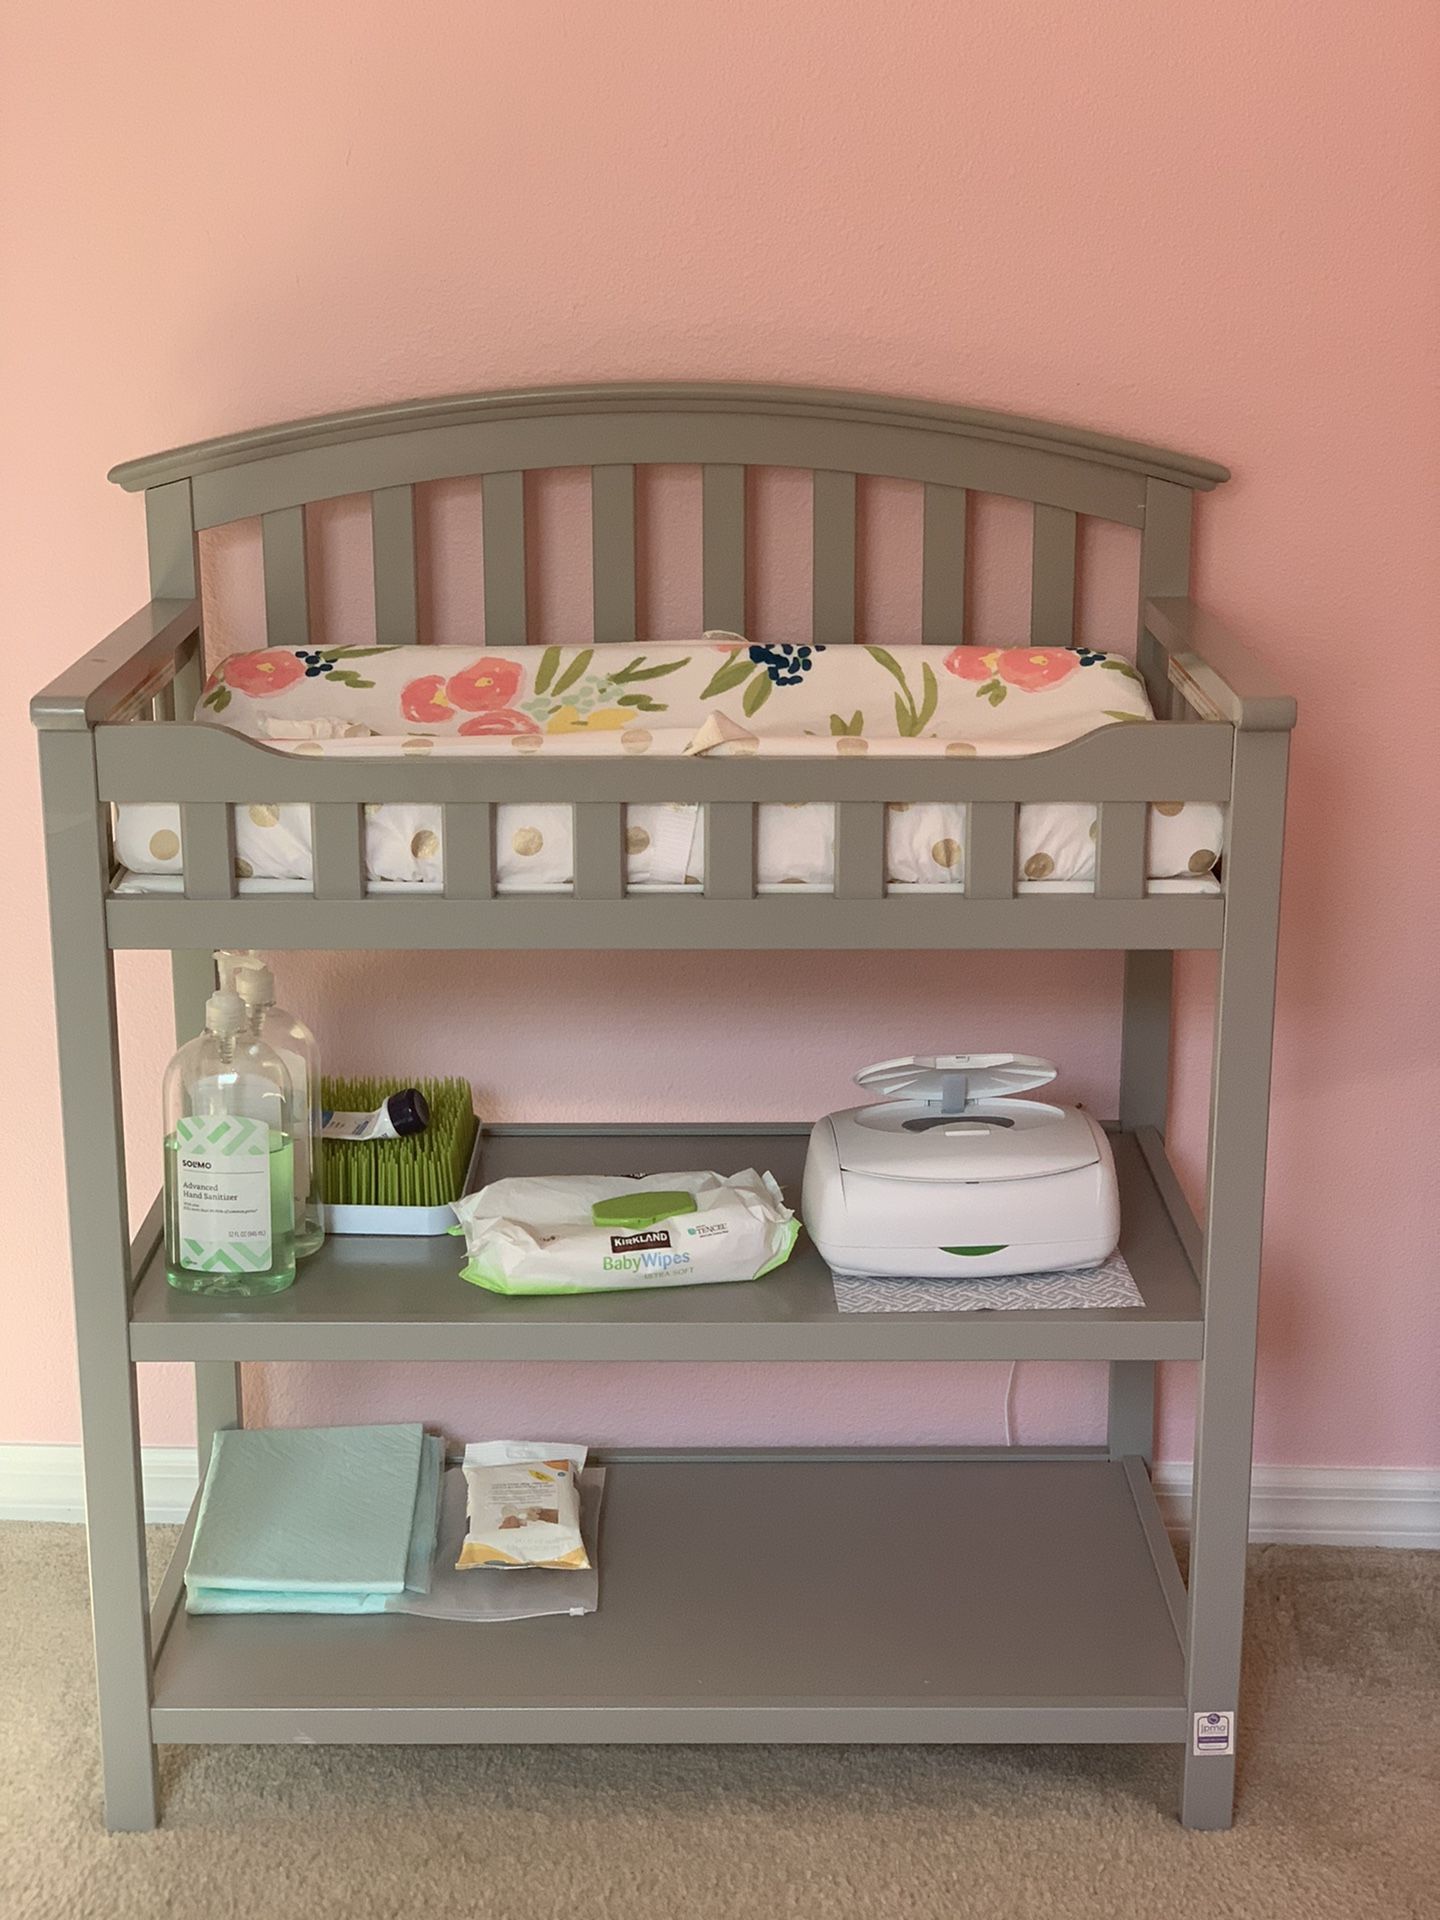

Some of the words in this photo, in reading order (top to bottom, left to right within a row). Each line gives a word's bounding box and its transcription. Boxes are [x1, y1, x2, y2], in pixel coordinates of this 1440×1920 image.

[183, 1181, 219, 1192] Advanced
[183, 1190, 203, 1200] Hand
[203, 1192, 238, 1201] Sanitizer
[614, 1233, 668, 1247] KIRKLAND
